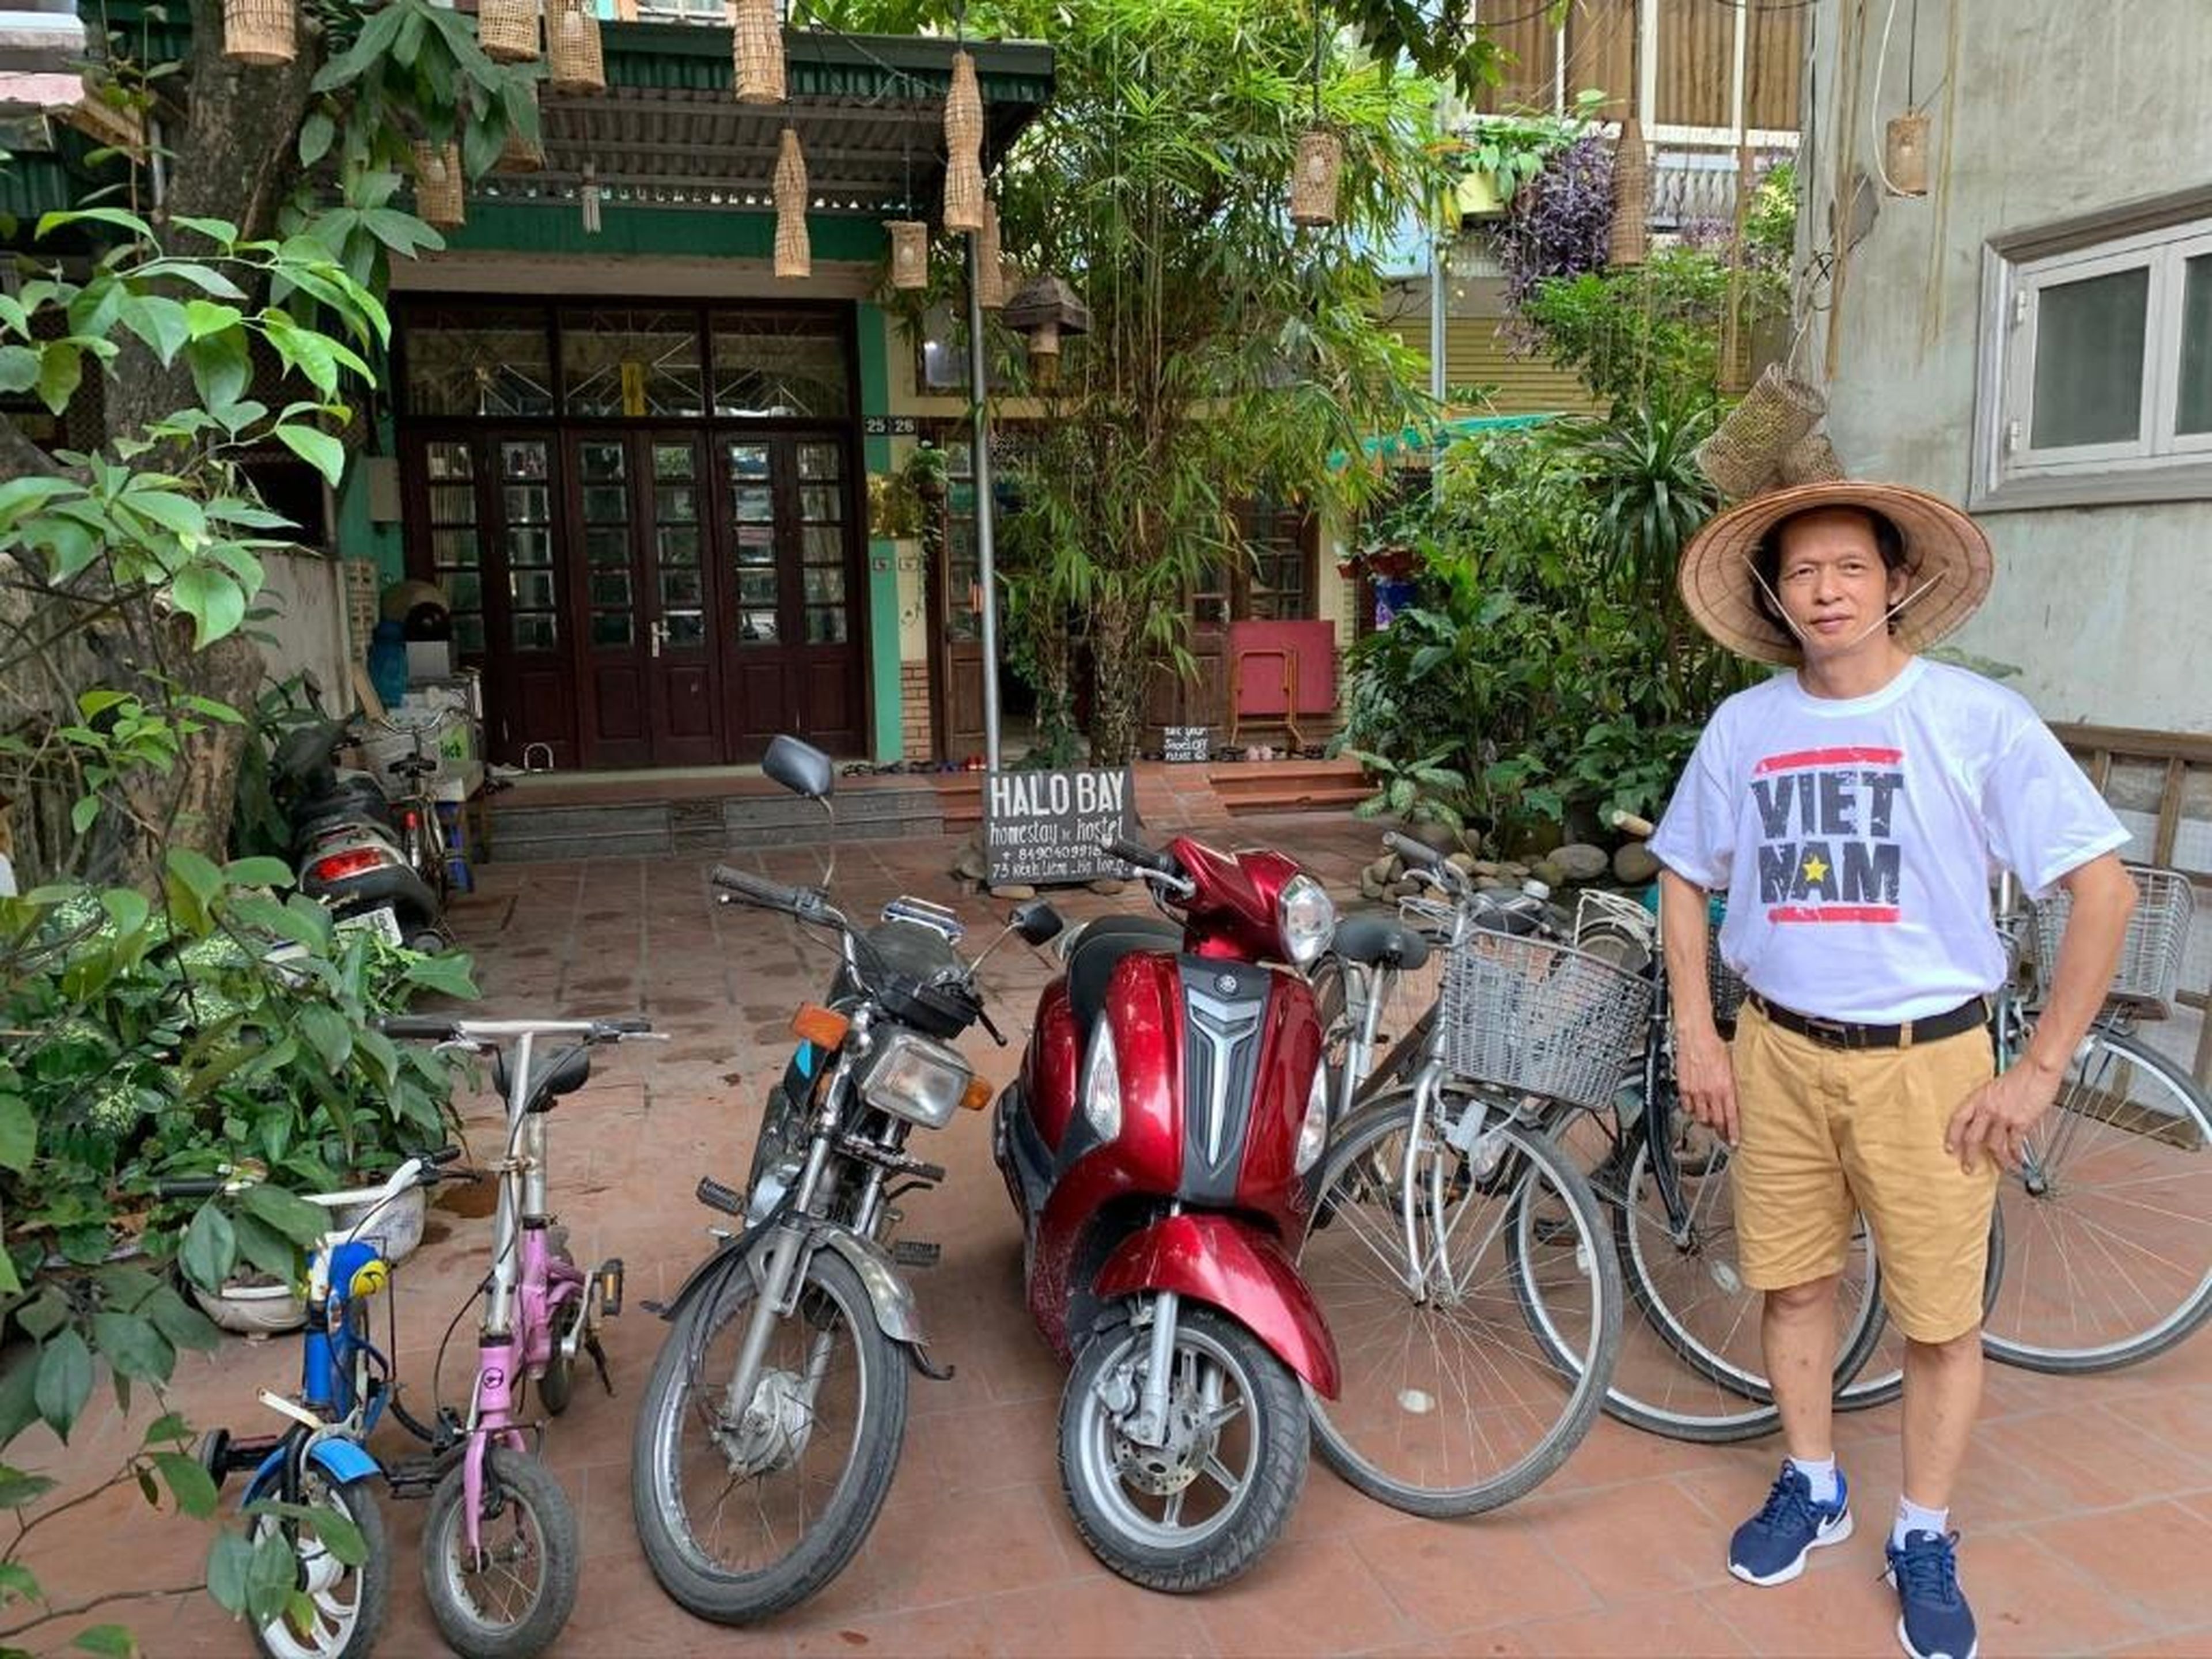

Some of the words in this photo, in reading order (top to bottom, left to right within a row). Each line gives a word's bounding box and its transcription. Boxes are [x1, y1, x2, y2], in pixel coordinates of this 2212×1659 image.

[867, 418, 885, 433] 25
[990, 773, 1070, 817] HALO
[1076, 771, 1124, 813] BAY
[1750, 770, 1904, 839] VIET
[990, 820, 1058, 846] homestay
[1758, 841, 1901, 904] NAM
